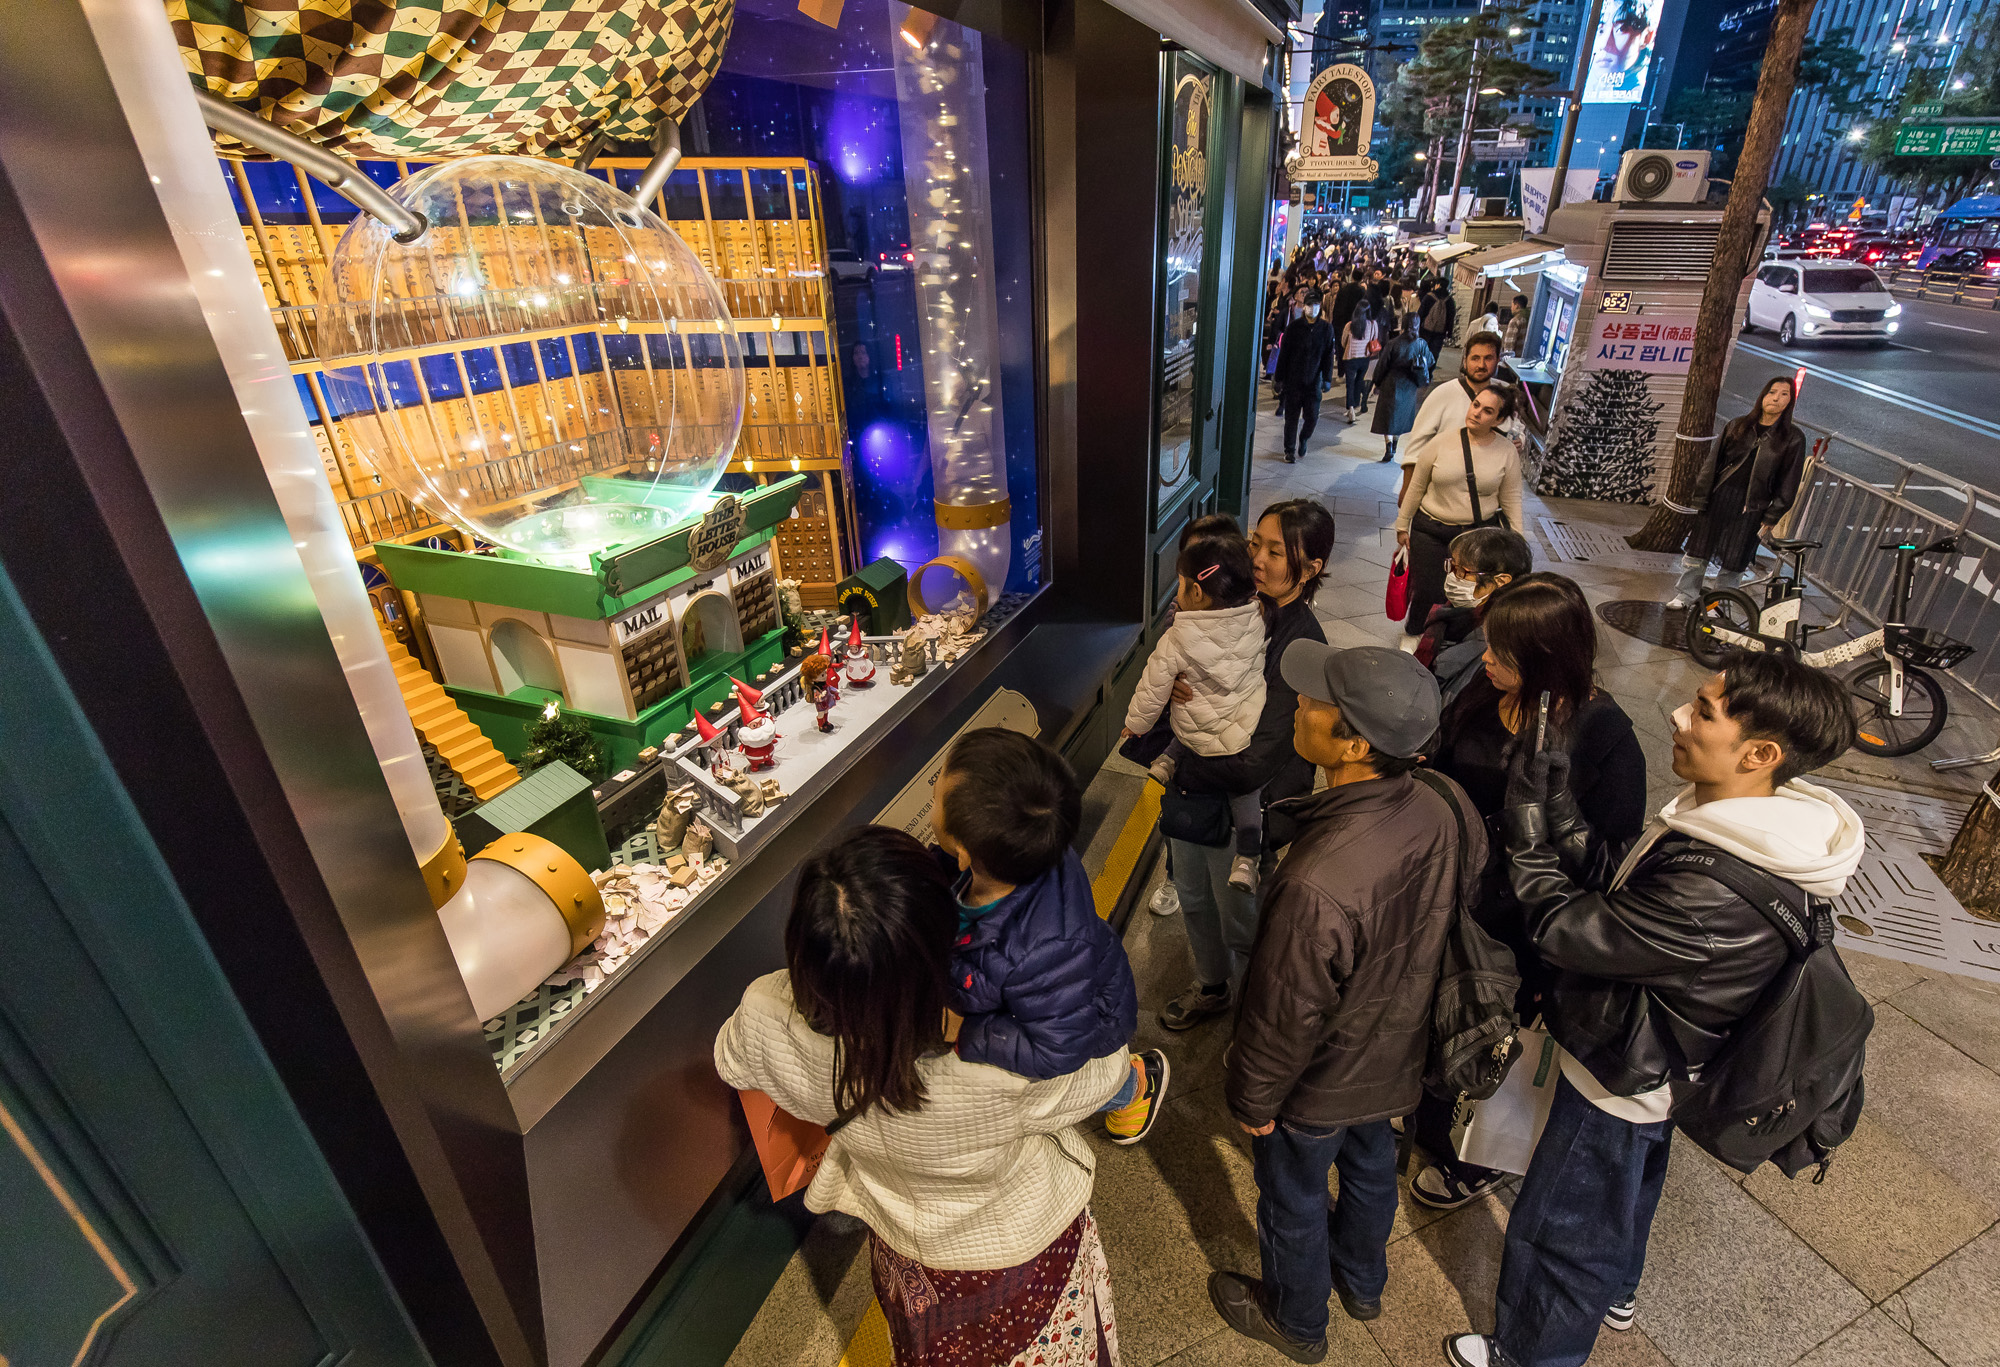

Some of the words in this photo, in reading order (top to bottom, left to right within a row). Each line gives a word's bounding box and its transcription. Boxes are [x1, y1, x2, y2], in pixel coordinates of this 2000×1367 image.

[1308, 73, 1328, 103] FAIRY
[1329, 67, 1354, 78] TALE
[1353, 70, 1373, 101] STORY
[1603, 297, 1628, 308] 85-2
[1597, 344, 1635, 360] 사고
[711, 505, 735, 525] THE
[697, 517, 740, 545] LETTER
[697, 530, 736, 558] HOUSE
[736, 555, 765, 582] MAIL
[839, 588, 852, 605] DEAR
[852, 586, 863, 595] MY
[864, 589, 879, 608] WISH
[624, 606, 662, 635] MAIL
[916, 802, 933, 820] YOUR
[1769, 898, 1809, 948] BURBERRY
